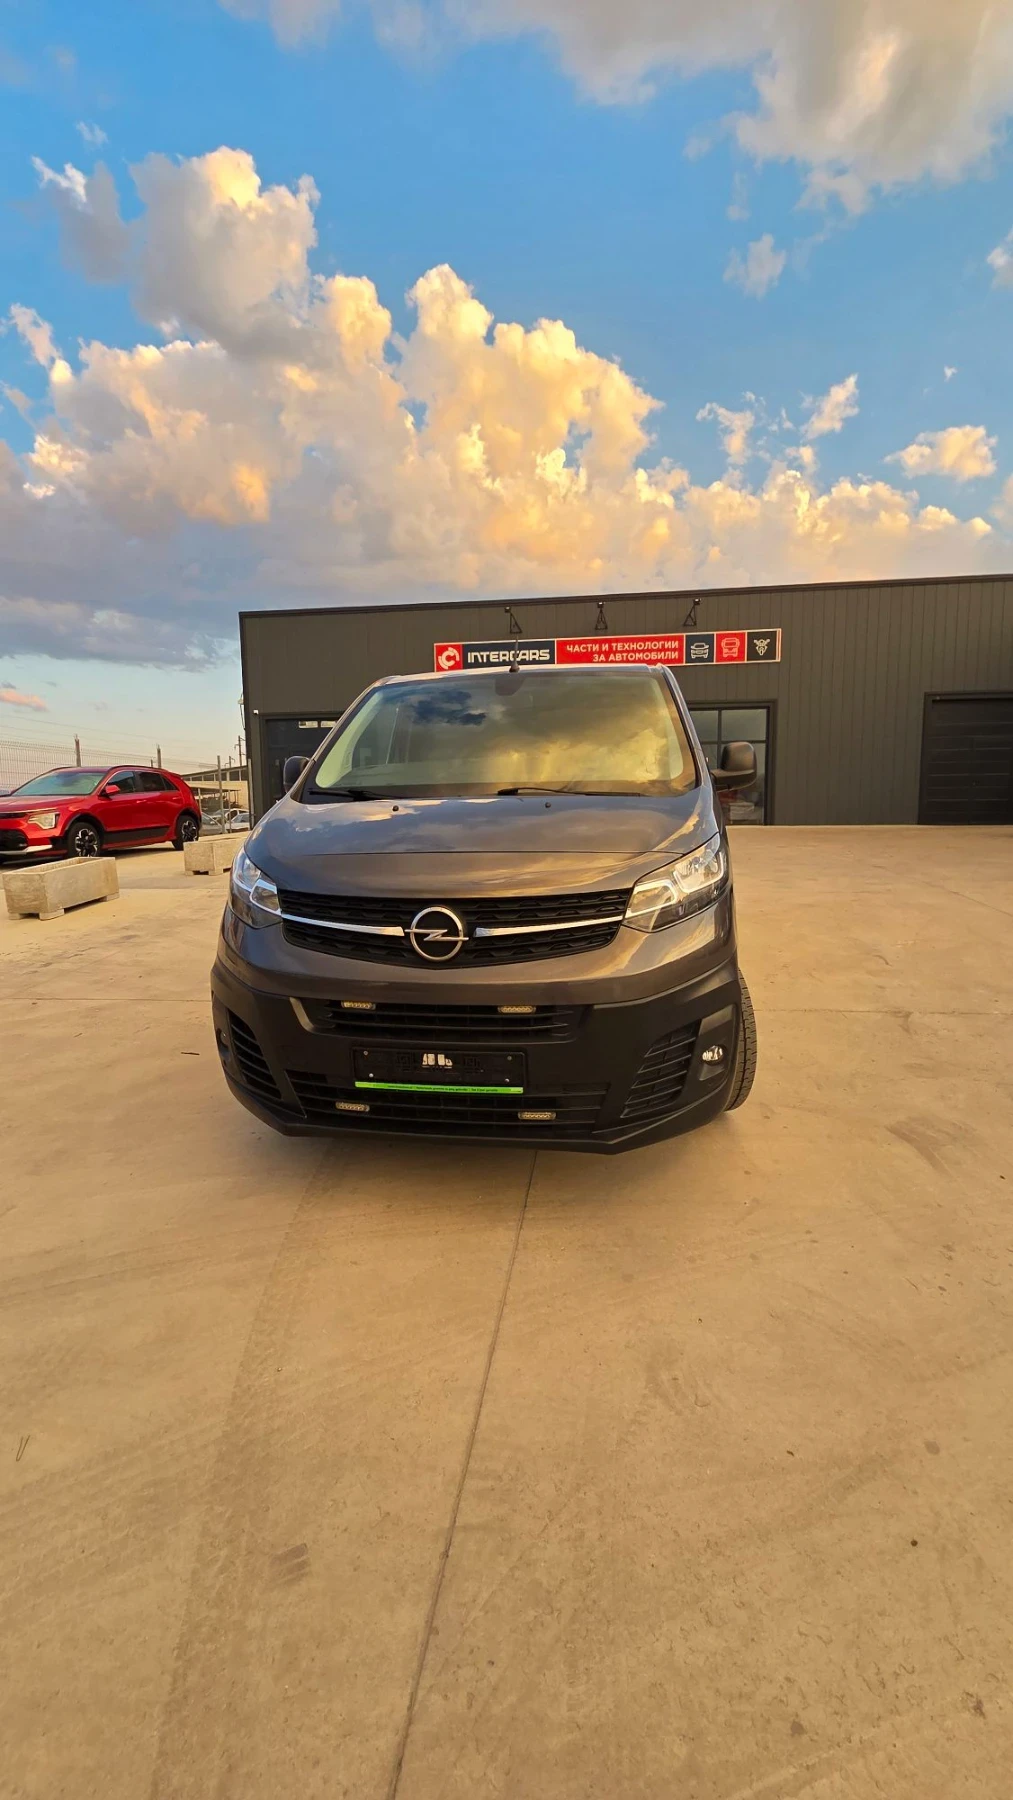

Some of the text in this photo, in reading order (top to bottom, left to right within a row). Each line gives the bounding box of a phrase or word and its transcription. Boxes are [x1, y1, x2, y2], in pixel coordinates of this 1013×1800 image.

[566, 641, 679, 653] ЧАСТИ И ТЕХНОЛОГИИ
[592, 651, 679, 662] ЗА АВТОМОБИЛИ
